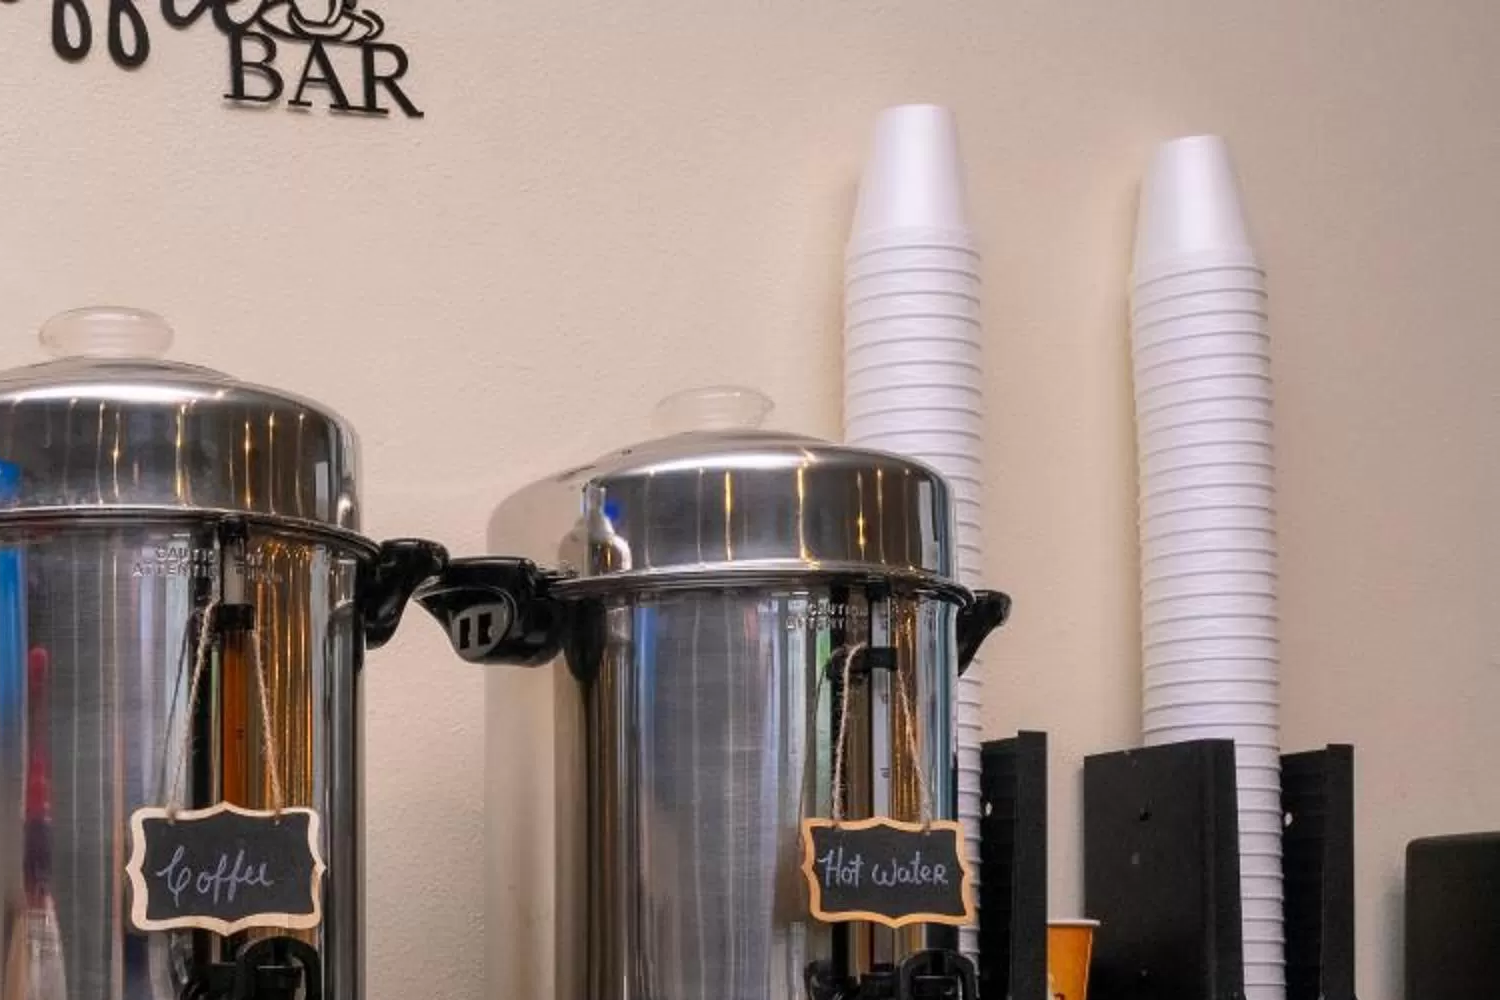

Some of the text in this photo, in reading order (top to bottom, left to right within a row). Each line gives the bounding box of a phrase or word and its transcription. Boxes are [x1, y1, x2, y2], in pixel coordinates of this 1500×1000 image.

[224, 31, 424, 118] BAR
[156, 846, 274, 907] Coffee
[816, 846, 865, 889] Hot
